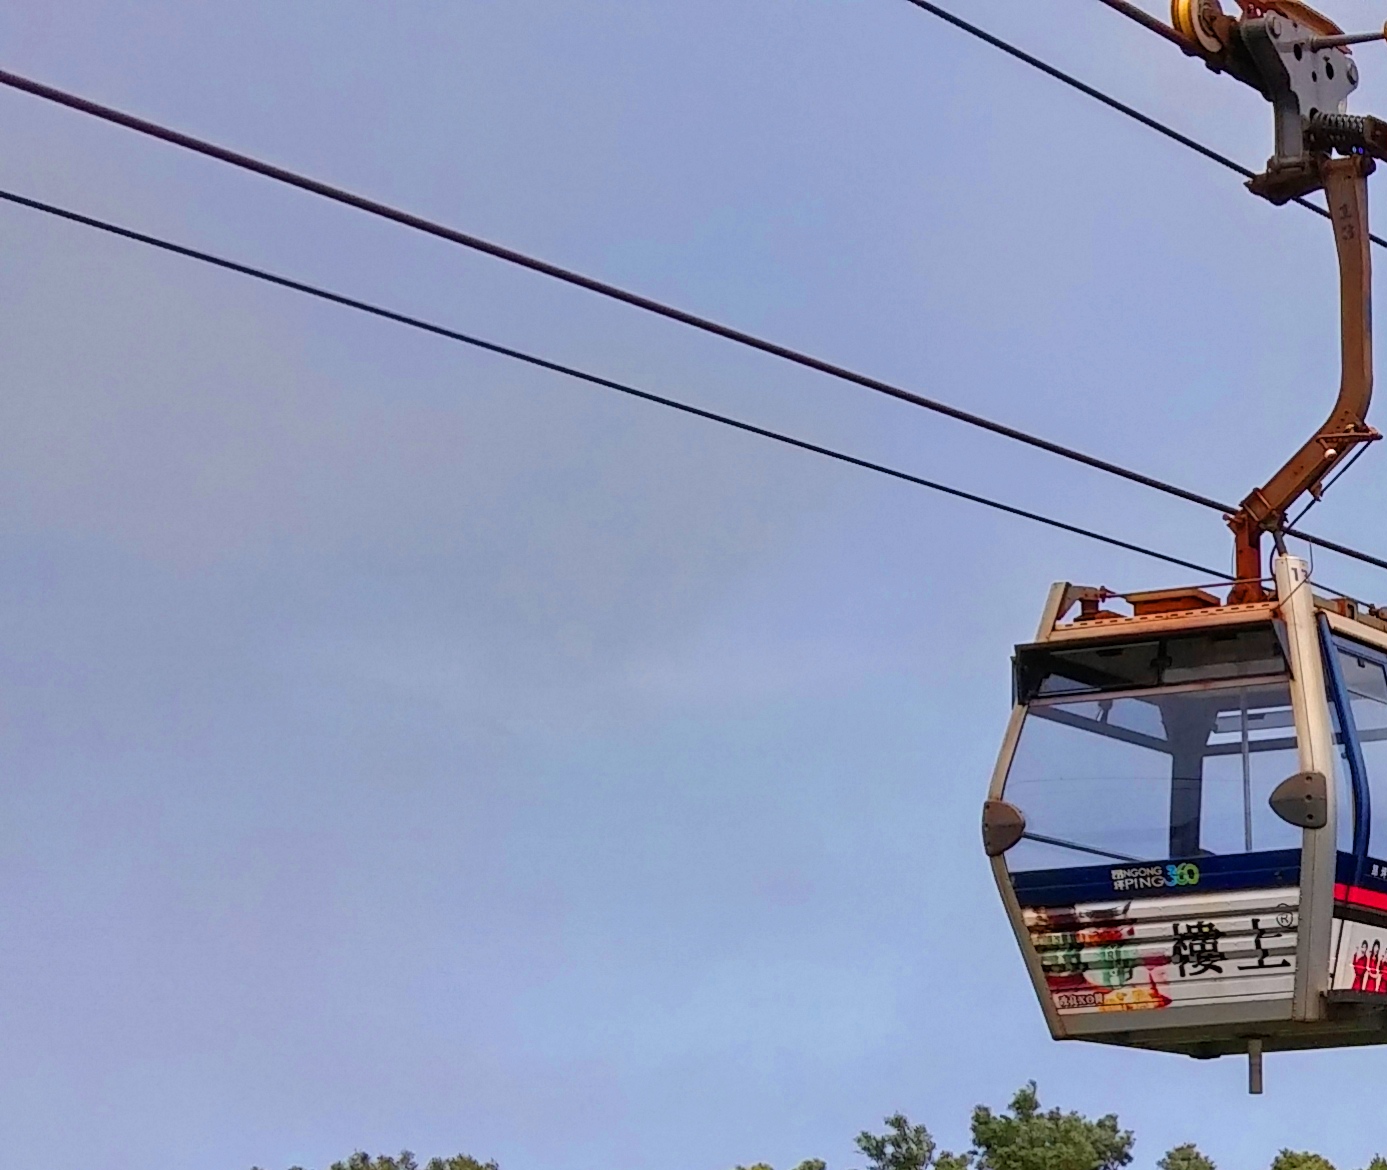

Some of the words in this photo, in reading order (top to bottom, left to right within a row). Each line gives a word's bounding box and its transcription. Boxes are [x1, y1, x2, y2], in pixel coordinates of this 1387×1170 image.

[1121, 865, 1163, 879] NGONG
[1164, 862, 1200, 888] 360
[1124, 876, 1165, 891] PING
